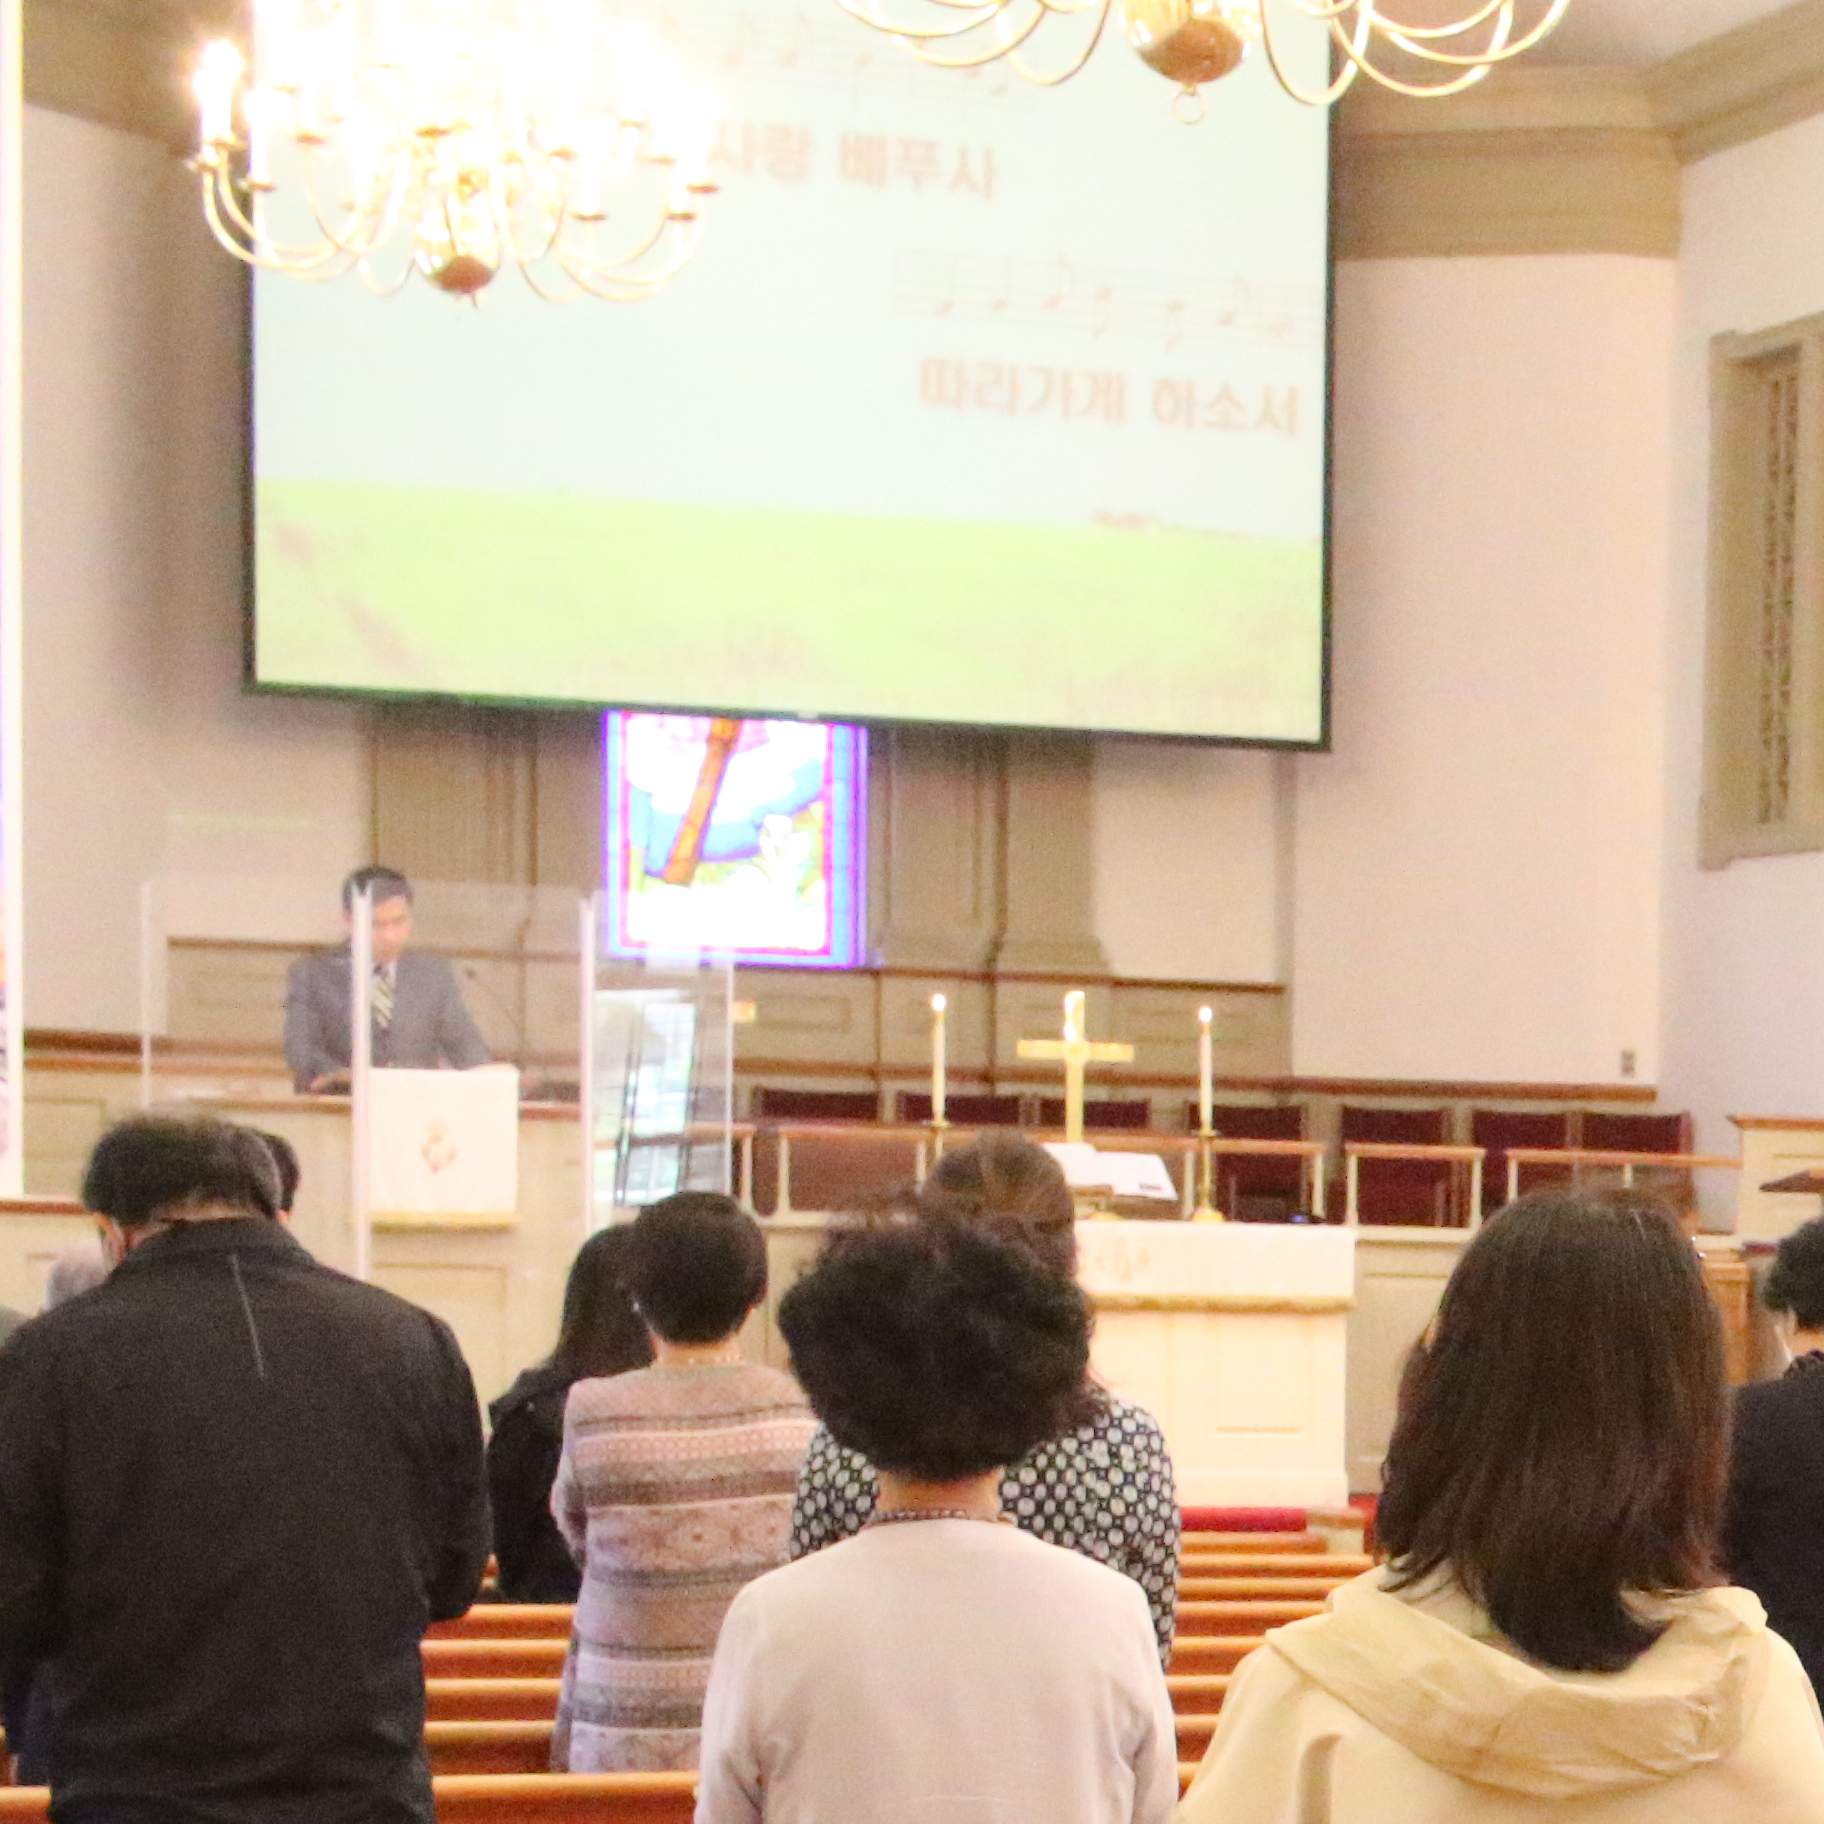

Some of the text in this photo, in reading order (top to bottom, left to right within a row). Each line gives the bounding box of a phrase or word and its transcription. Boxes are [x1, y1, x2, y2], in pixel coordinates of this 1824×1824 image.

[708, 121, 812, 180] 사랑
[919, 356, 1299, 437] 따라가게 하소서
